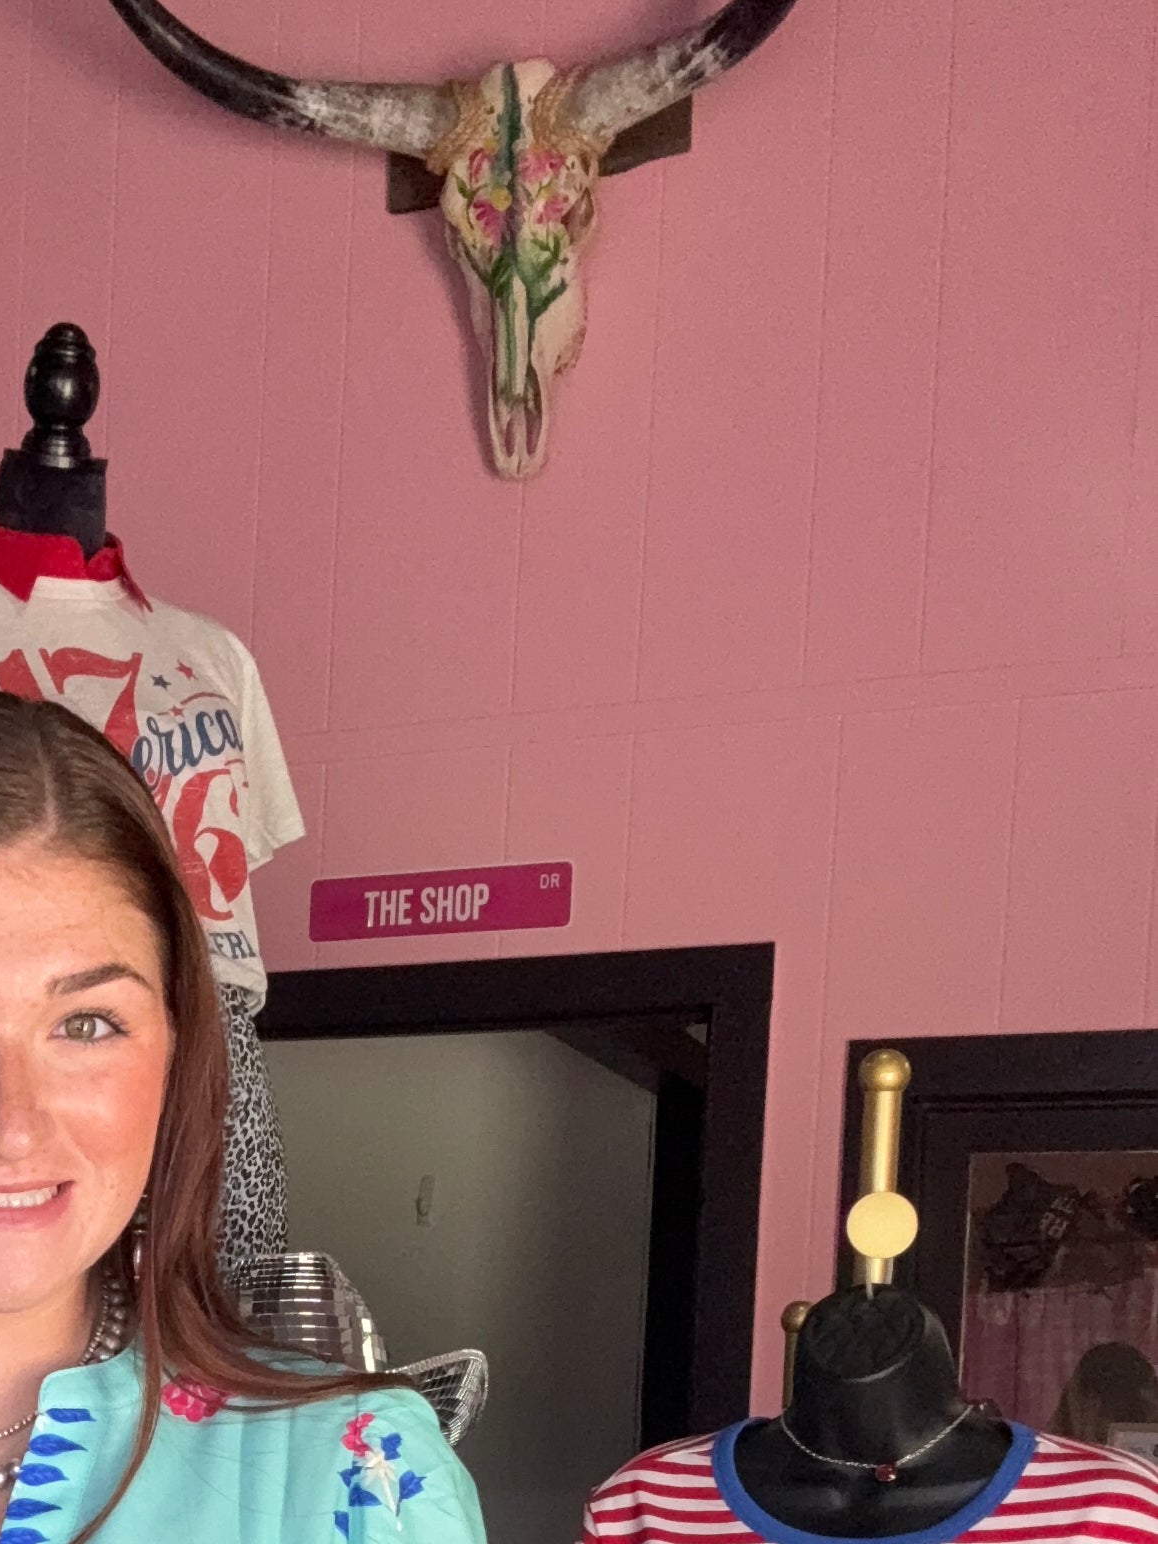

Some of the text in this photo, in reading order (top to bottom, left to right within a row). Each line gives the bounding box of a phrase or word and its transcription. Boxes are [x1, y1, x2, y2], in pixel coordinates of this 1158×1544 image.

[364, 873, 560, 928] THE SHOP DR
